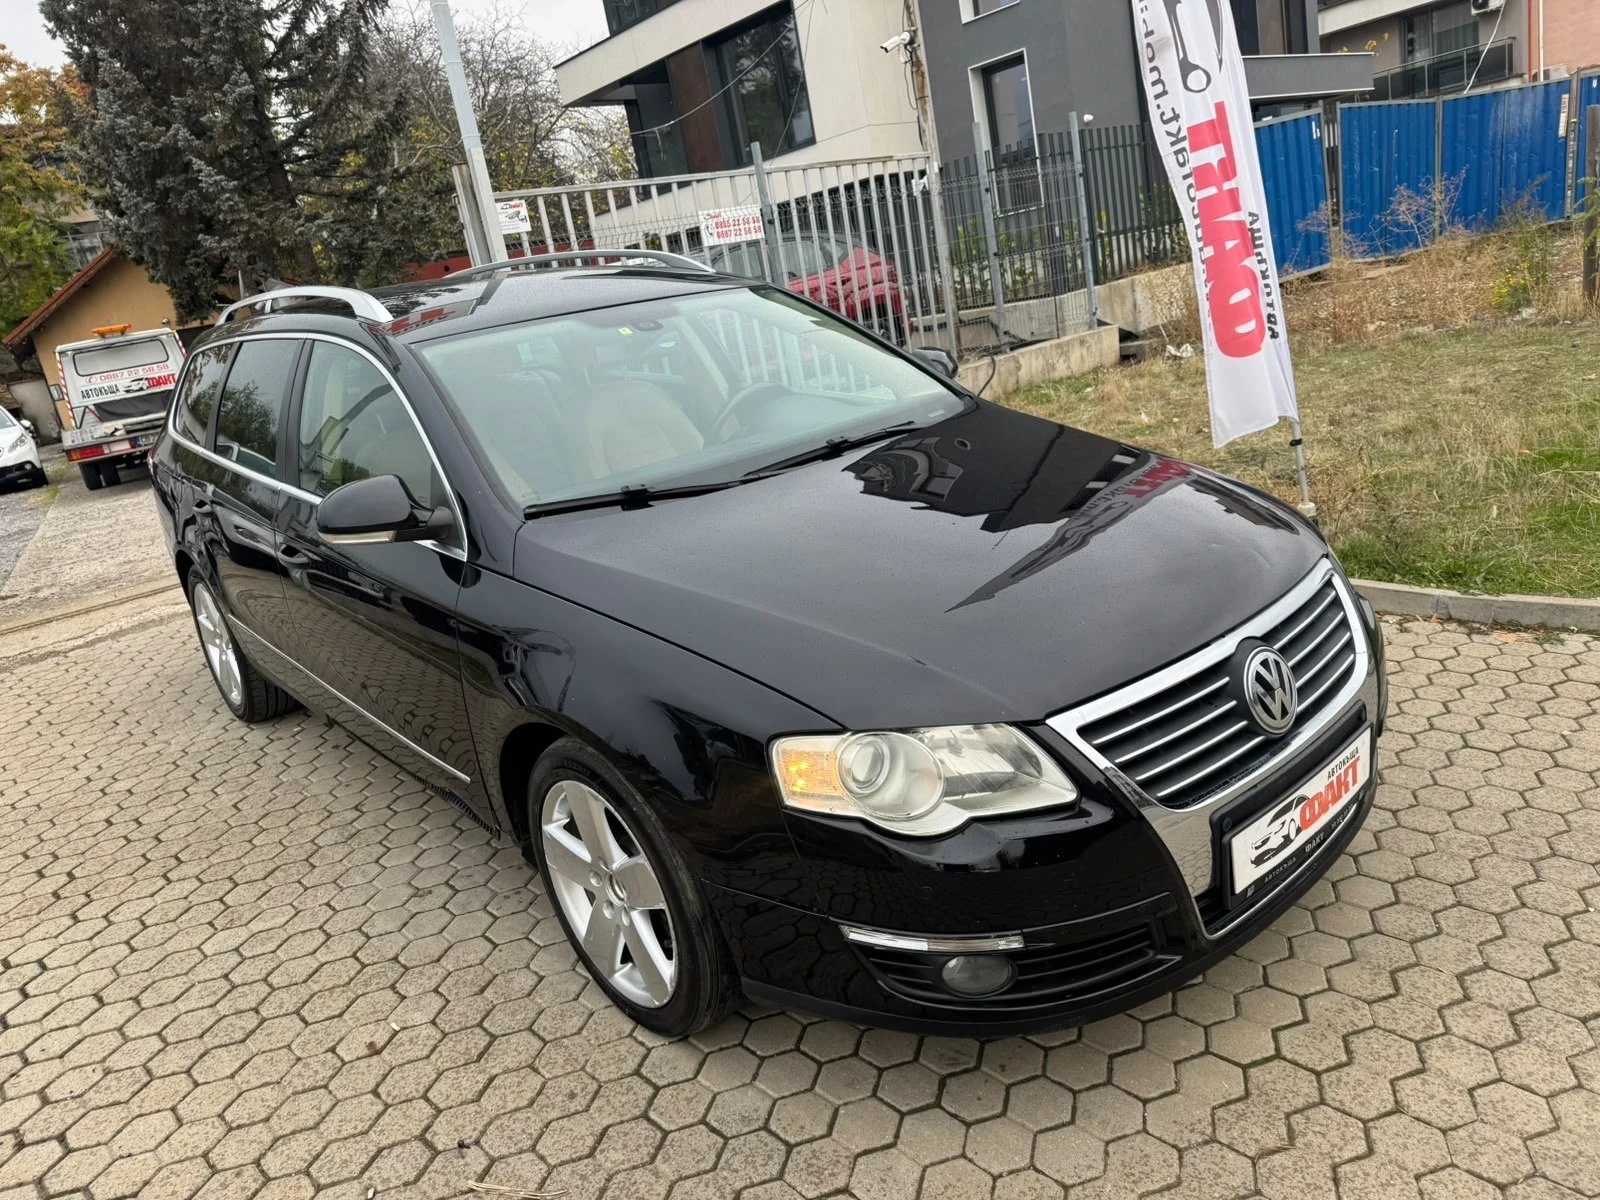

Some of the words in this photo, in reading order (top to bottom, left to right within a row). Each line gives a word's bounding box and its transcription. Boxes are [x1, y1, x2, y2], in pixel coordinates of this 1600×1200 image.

[733, 227, 742, 237] 22
[100, 372, 124, 381] 0887
[156, 363, 169, 371] 58
[147, 374, 176, 388] ФАКТ
[81, 384, 120, 399] АВТОКЪЩА
[1327, 747, 1359, 780] АВТОКЪЩА
[1299, 757, 1361, 832] ФАКТ
[1304, 831, 1325, 853] ФАКТ
